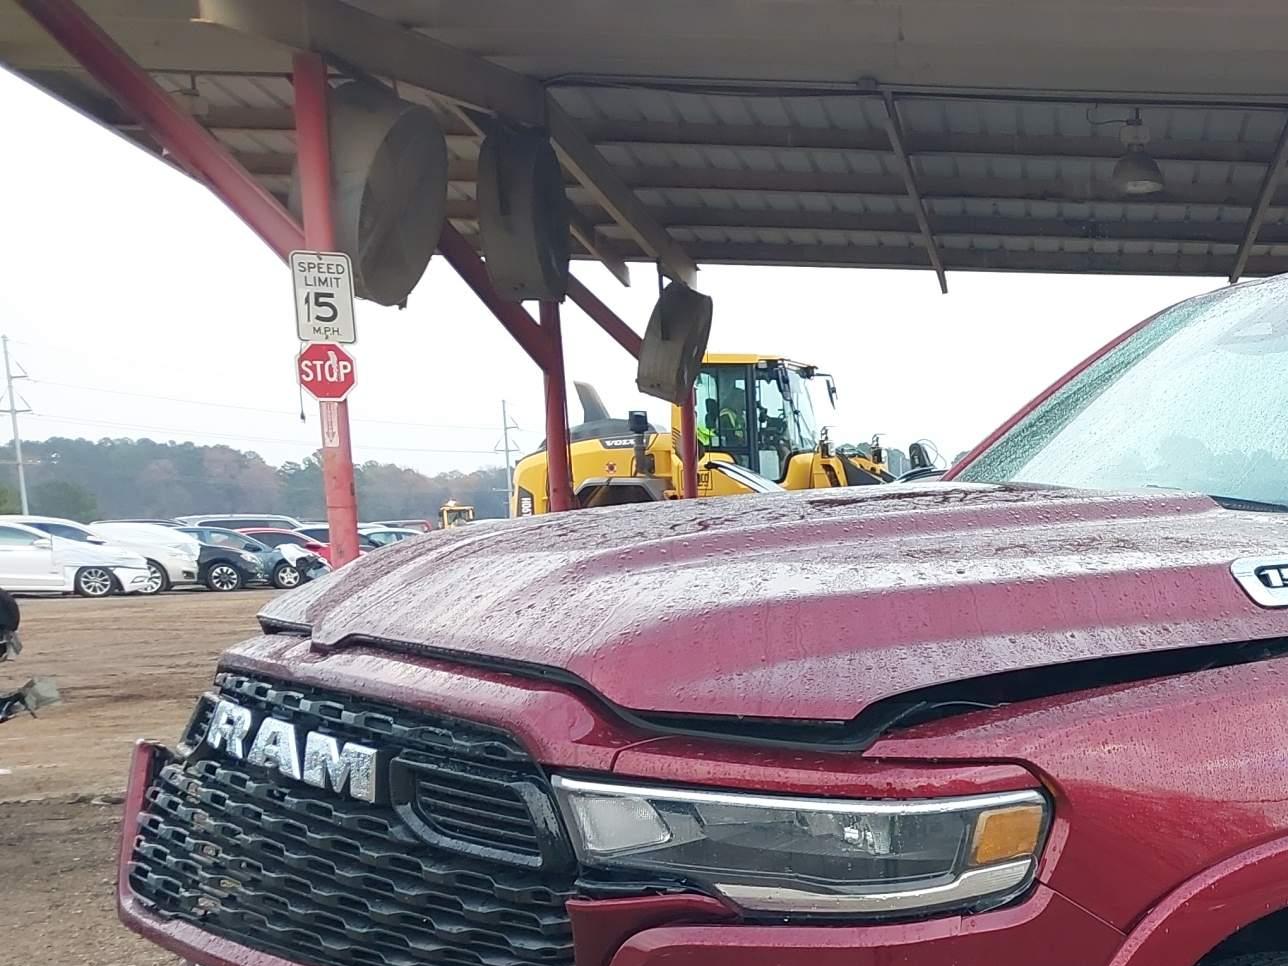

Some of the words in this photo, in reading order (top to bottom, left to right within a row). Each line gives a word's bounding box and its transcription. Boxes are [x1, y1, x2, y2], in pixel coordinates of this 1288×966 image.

[299, 262, 345, 275] SPEED
[304, 277, 341, 289] LIMIT
[304, 292, 338, 322] 15
[301, 359, 351, 382] STOP
[207, 701, 377, 804] RAM
